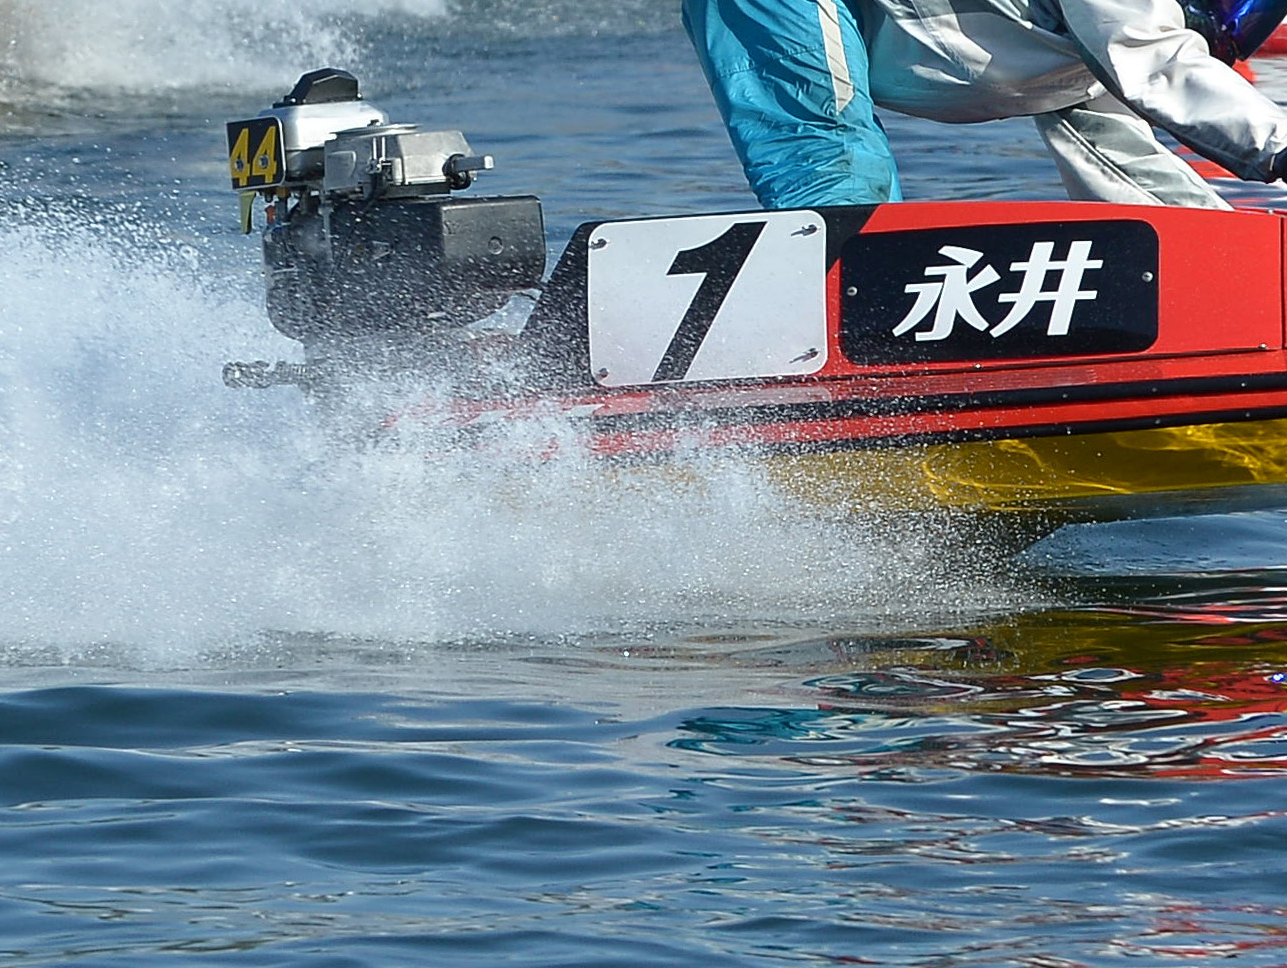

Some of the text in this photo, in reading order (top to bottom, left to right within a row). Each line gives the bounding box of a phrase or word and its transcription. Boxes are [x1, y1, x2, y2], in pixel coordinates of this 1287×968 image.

[230, 125, 277, 187] 44
[651, 220, 768, 383] 1
[892, 240, 1104, 342] 永井
